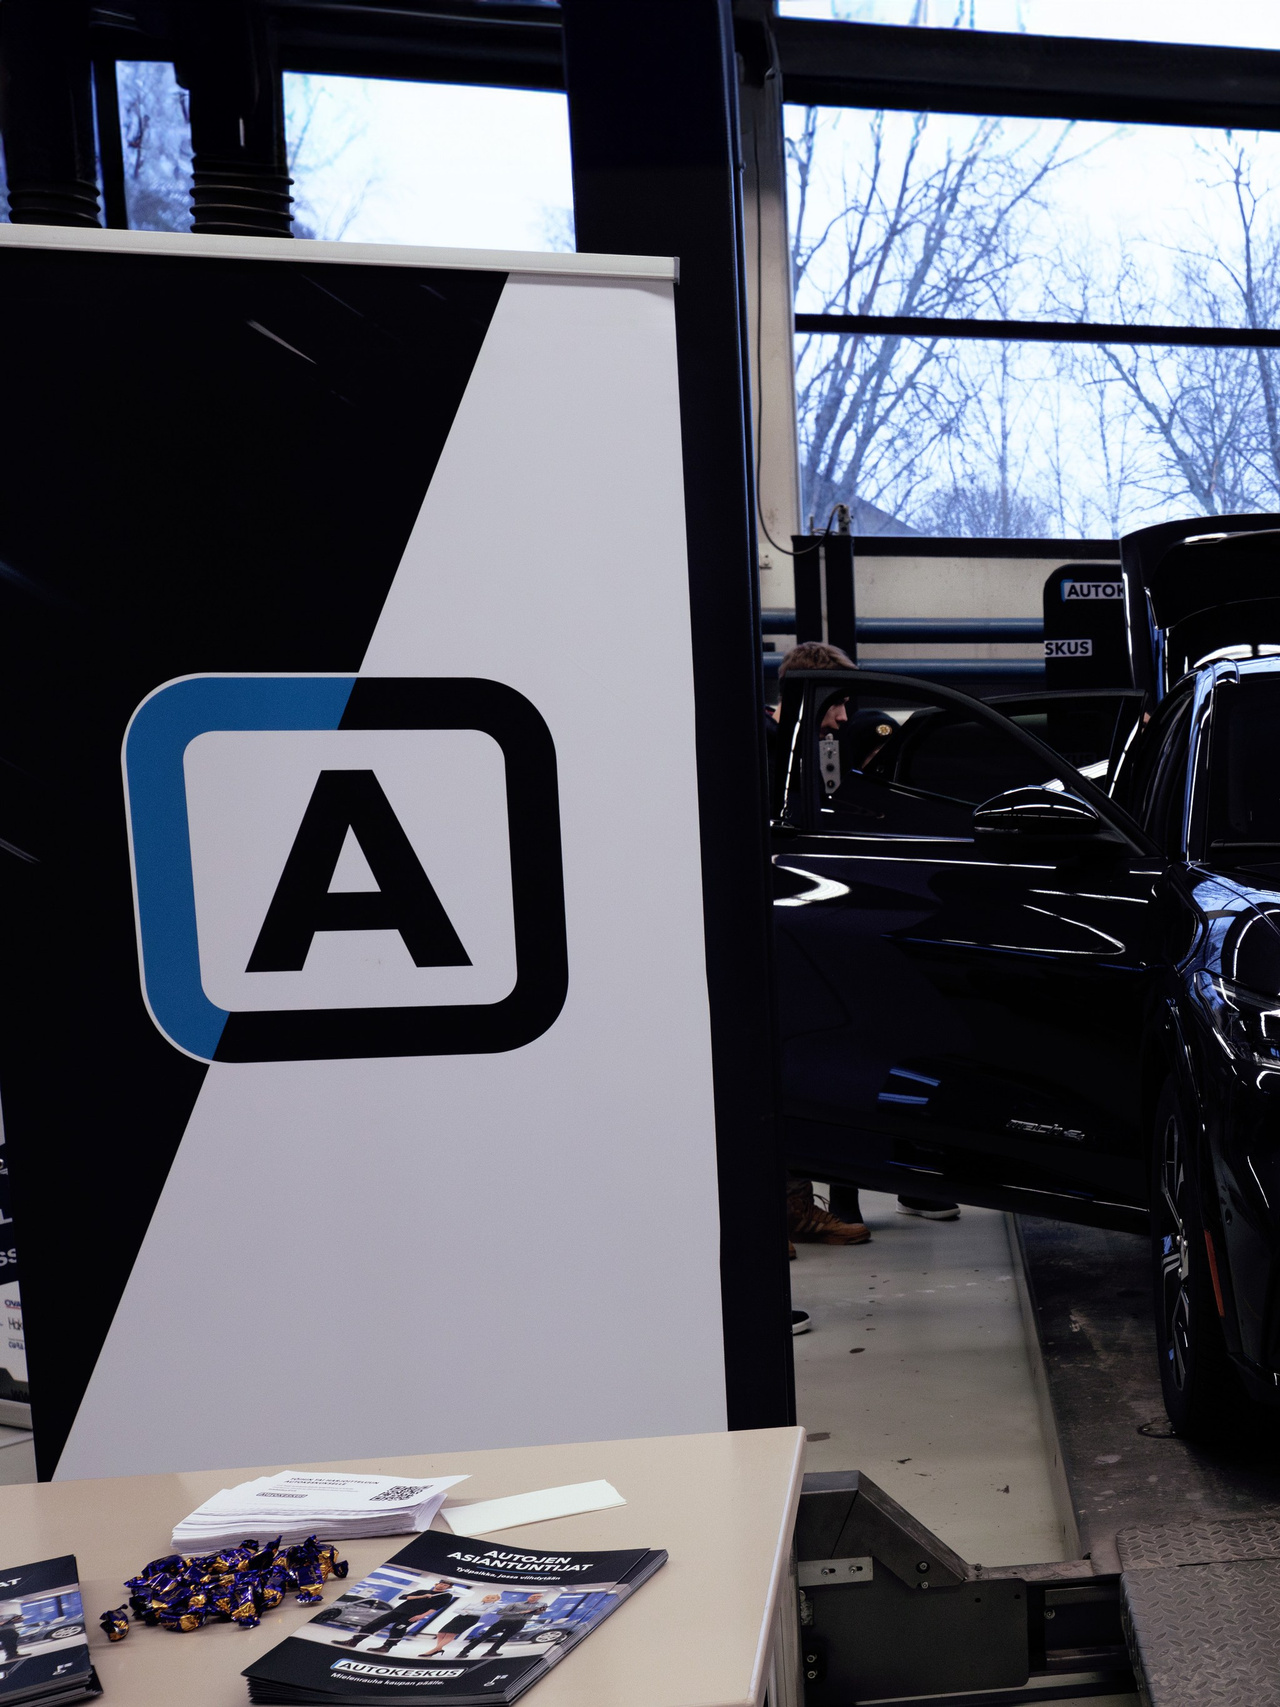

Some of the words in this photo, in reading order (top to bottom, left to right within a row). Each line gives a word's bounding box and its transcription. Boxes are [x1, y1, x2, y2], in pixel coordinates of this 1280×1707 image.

[245, 769, 474, 974] A
[447, 1551, 594, 1572] ASIANTUNTIJAT
[483, 1550, 572, 1564] AUTOJEN
[339, 1662, 459, 1677] AUTOKESKUS
[330, 1672, 384, 1685] Mielenrauha
[384, 1679, 416, 1687] kaupan
